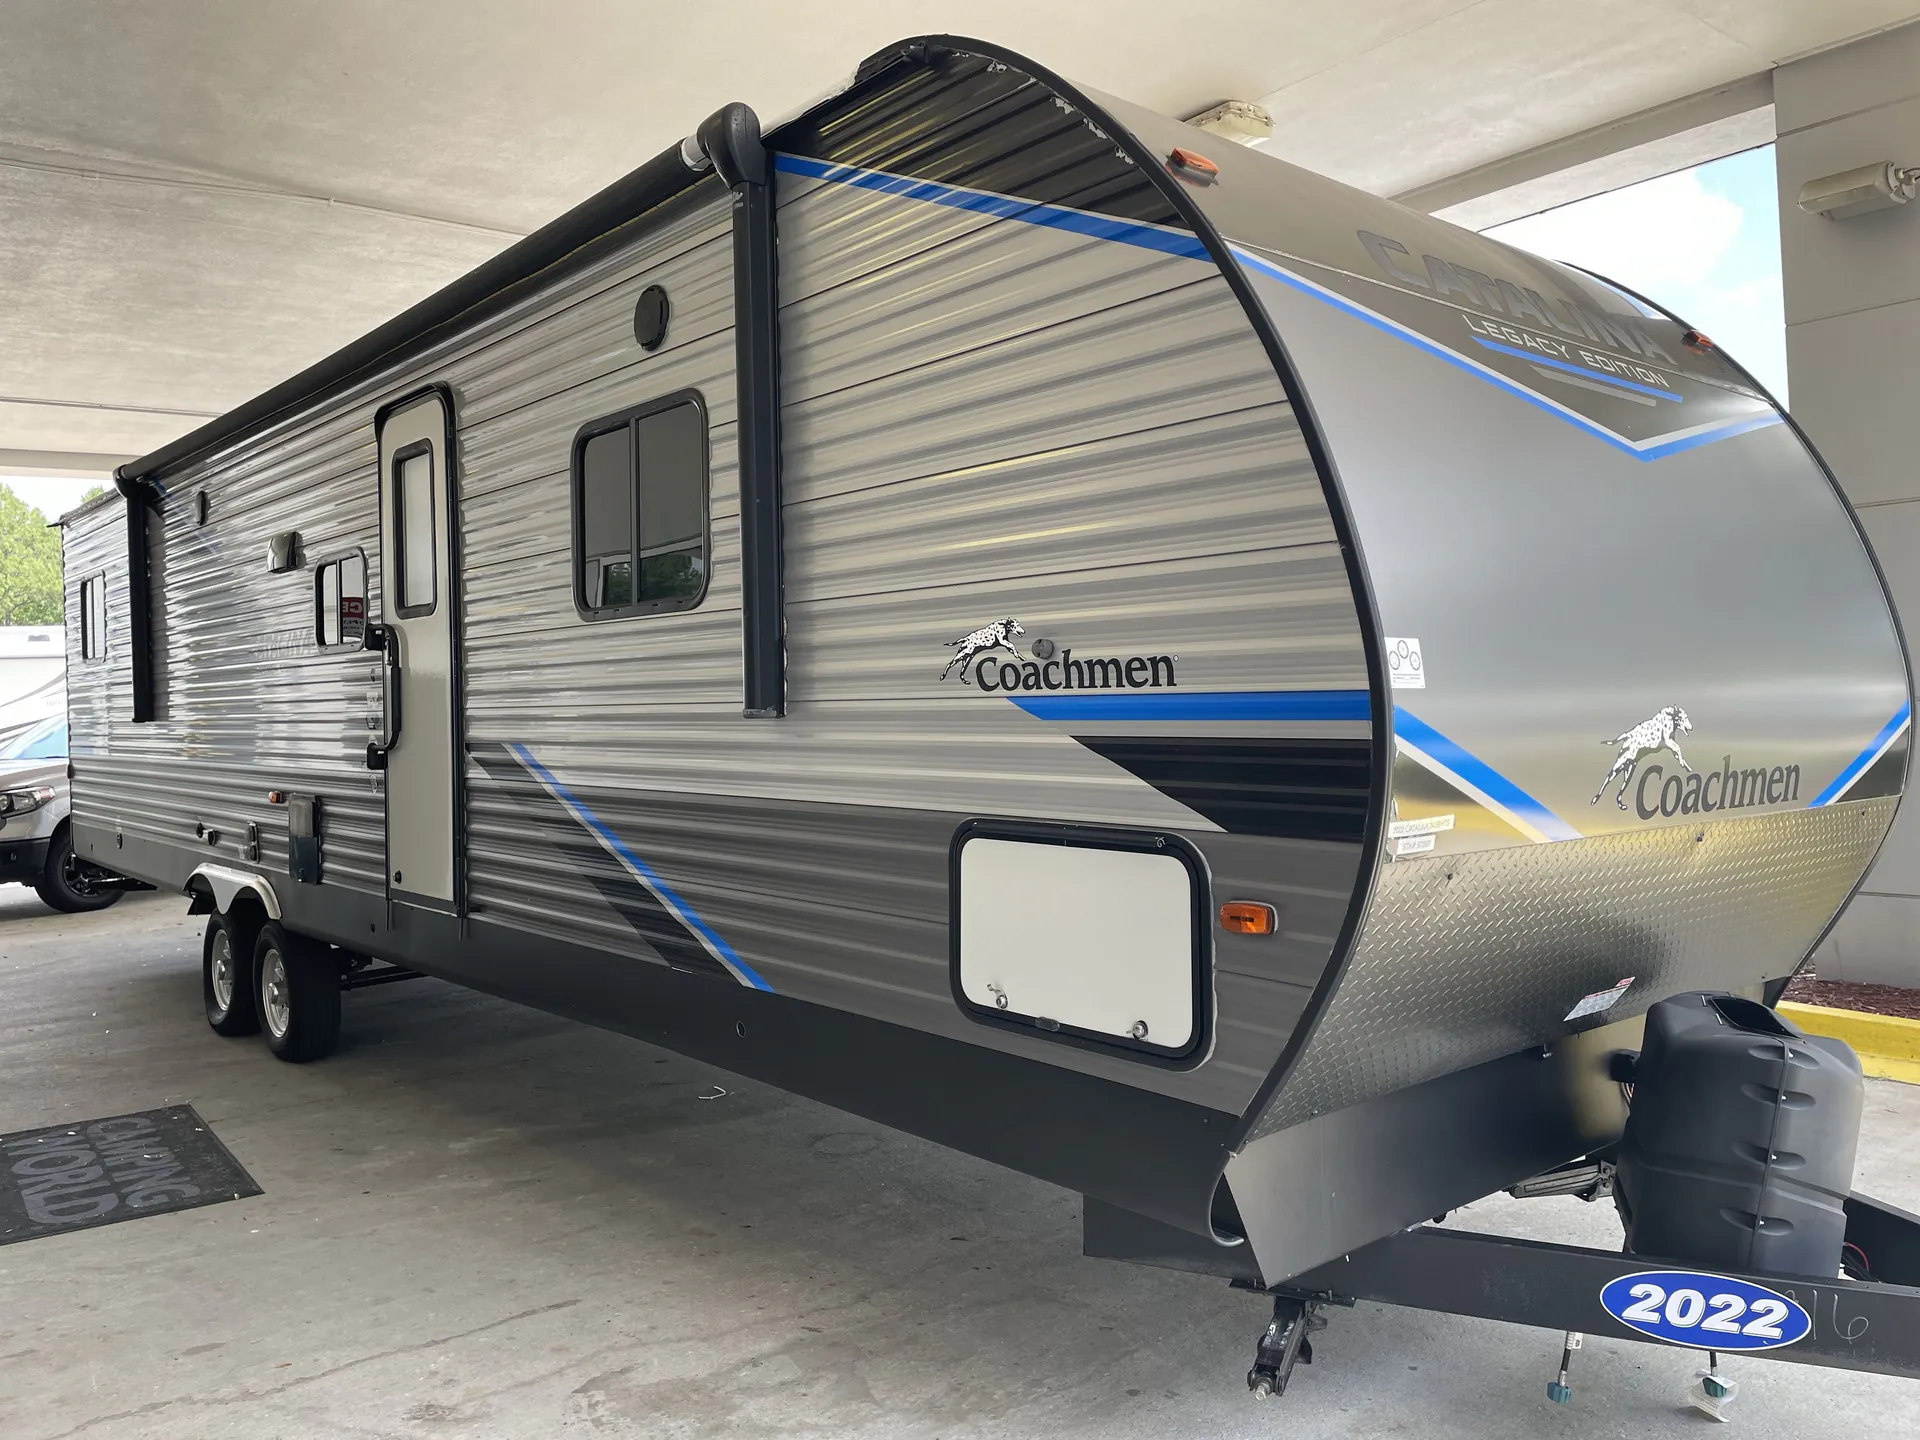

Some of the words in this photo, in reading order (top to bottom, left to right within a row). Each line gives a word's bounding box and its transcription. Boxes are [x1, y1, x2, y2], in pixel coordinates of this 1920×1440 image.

[1356, 229, 1679, 366] CATALINA
[1462, 314, 1570, 359] LEGACY
[1578, 350, 1670, 388] EDITION
[975, 648, 1177, 692] Coachmen
[1636, 754, 1800, 820] Coachmen
[3, 1126, 119, 1224] WORLD
[86, 1117, 200, 1207] CAMPING
[1621, 1283, 1789, 1340] 2022
